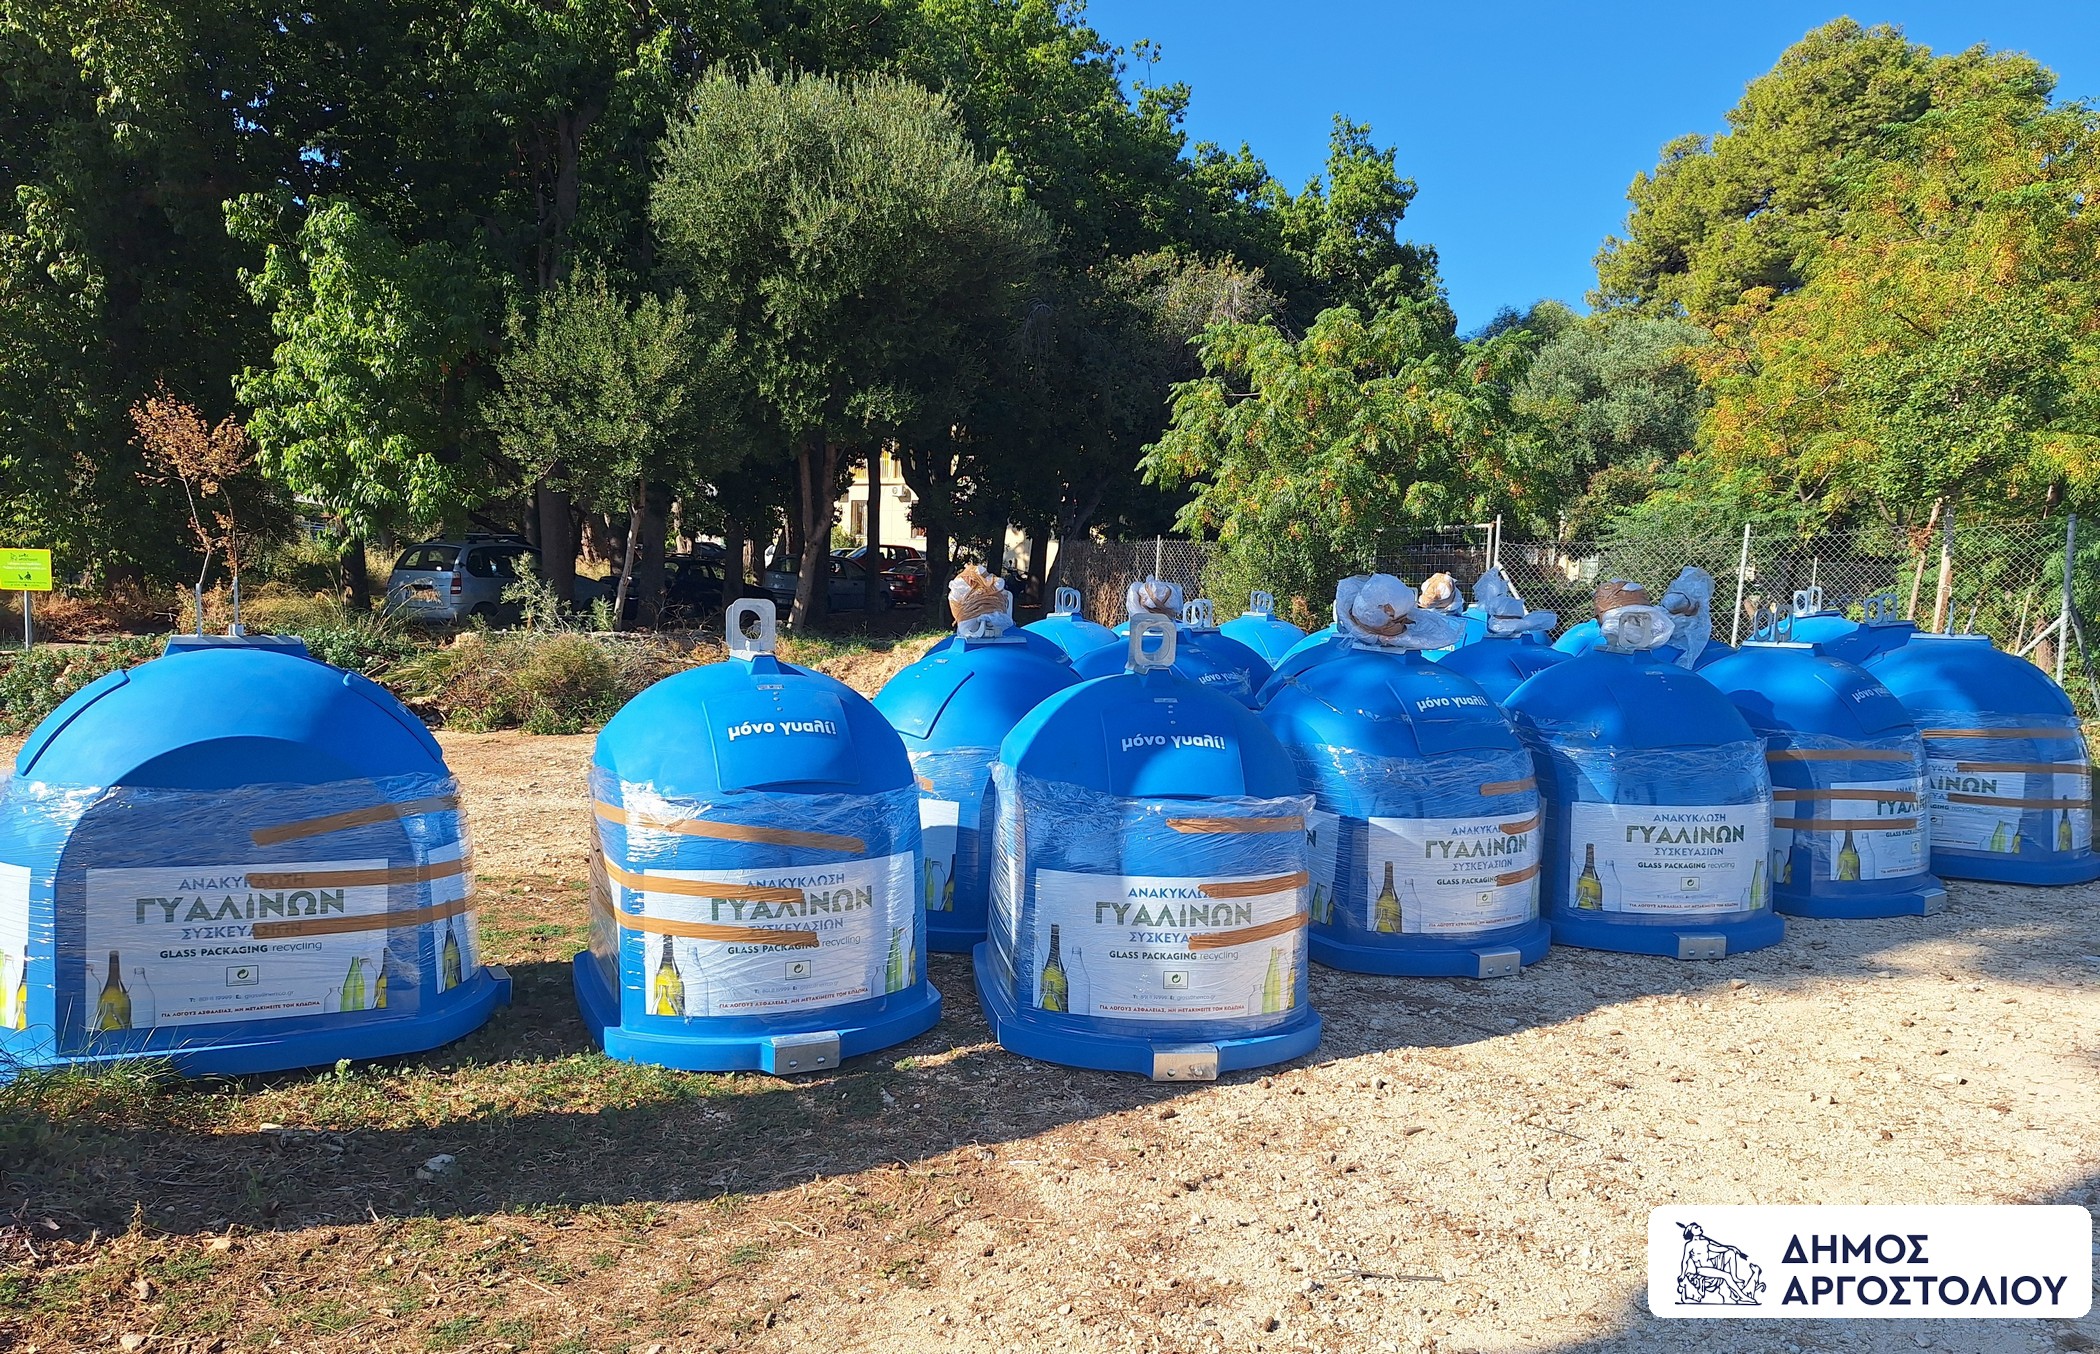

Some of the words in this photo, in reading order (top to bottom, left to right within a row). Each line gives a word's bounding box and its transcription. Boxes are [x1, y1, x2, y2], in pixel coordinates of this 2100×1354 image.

[1416, 696, 1450, 713] μόνο
[1451, 695, 1489, 708] γυαλί!
[1852, 688, 1875, 704] μόνο
[728, 720, 775, 742] μόνο
[780, 719, 837, 736] γυαλί!
[1121, 733, 1166, 752] μόνο
[1170, 734, 1226, 749] γυαλί!
[1653, 813, 1726, 823] ΑΝΑΚΥΚΛΩΣΗ
[1451, 825, 1501, 835] ΑΝΑΚΥΚΛ
[1626, 825, 1745, 844] ΓΥΑΛΙΝΩΝ
[1425, 834, 1528, 859] ΓΥΑΛΙΝΩΝ
[1654, 847, 1724, 856] ΣΥΣΚΕΥΑΣΙΩΝ
[1452, 859, 1513, 872] ΣΥΣΚΕΥΑΣΙΩΝ
[1638, 861, 1662, 869] GLASS
[1707, 861, 1735, 870] recycling
[746, 873, 845, 889] ΑΝΑΚΥΚΛΩΣΗ
[1437, 878, 1460, 886] GLASS
[1128, 888, 1220, 899] ΑΝΑΚΥΚΛΩ
[136, 889, 345, 924] ΓΥΑΛΙΝΩΝ
[711, 885, 873, 922] ΓΥΑΛΙΝΩΝ
[1095, 901, 1252, 927] ΓΥΑΛΙΝΩΝ
[748, 918, 844, 934] ΚΕΥΑΣΙΩΝ
[728, 945, 759, 955] GLASS
[822, 935, 861, 948] recycling
[1129, 931, 1219, 943] ΣΥΣΚΕΥΑ
[160, 949, 197, 959] GLASS
[201, 945, 268, 957] PACKAGING
[272, 941, 323, 953] recycling
[1109, 950, 1139, 960] GLASS
[1142, 951, 1197, 960] PACKAGING
[1200, 950, 1239, 961] recycling
